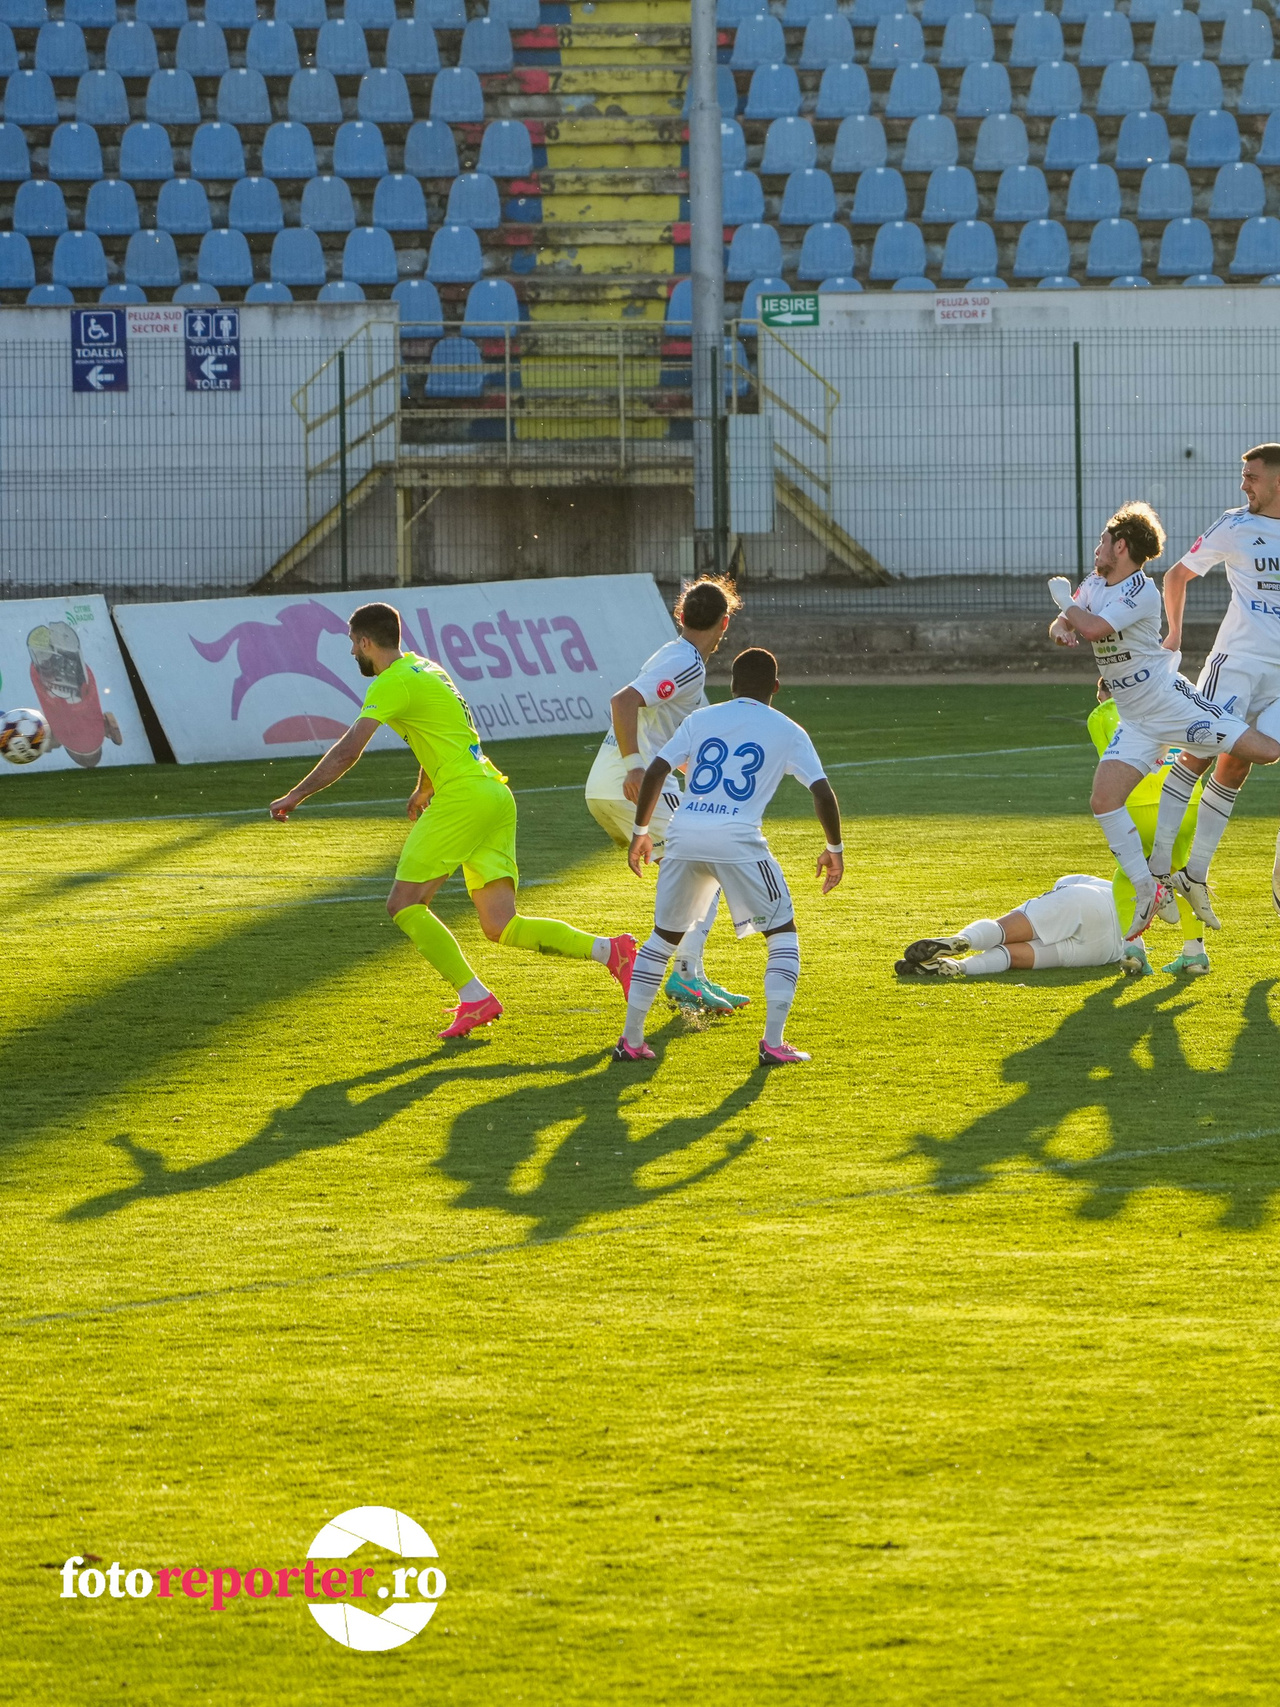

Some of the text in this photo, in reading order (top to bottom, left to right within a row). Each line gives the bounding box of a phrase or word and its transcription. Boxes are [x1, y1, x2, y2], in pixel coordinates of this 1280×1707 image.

[549, 72, 562, 90] 7
[764, 298, 817, 311] IESIRE
[936, 297, 990, 307] PELUZA SUD
[128, 312, 182, 322] PELUZA SUD
[940, 310, 987, 320] SECTOR F
[132, 324, 178, 334] SECTOR E
[75, 348, 124, 358] TOALETA
[189, 346, 238, 356] TOALETA
[194, 379, 232, 390] TOILET
[516, 691, 593, 724] Elsaco
[689, 736, 766, 802] 83
[685, 801, 740, 816] ALDAIR. F
